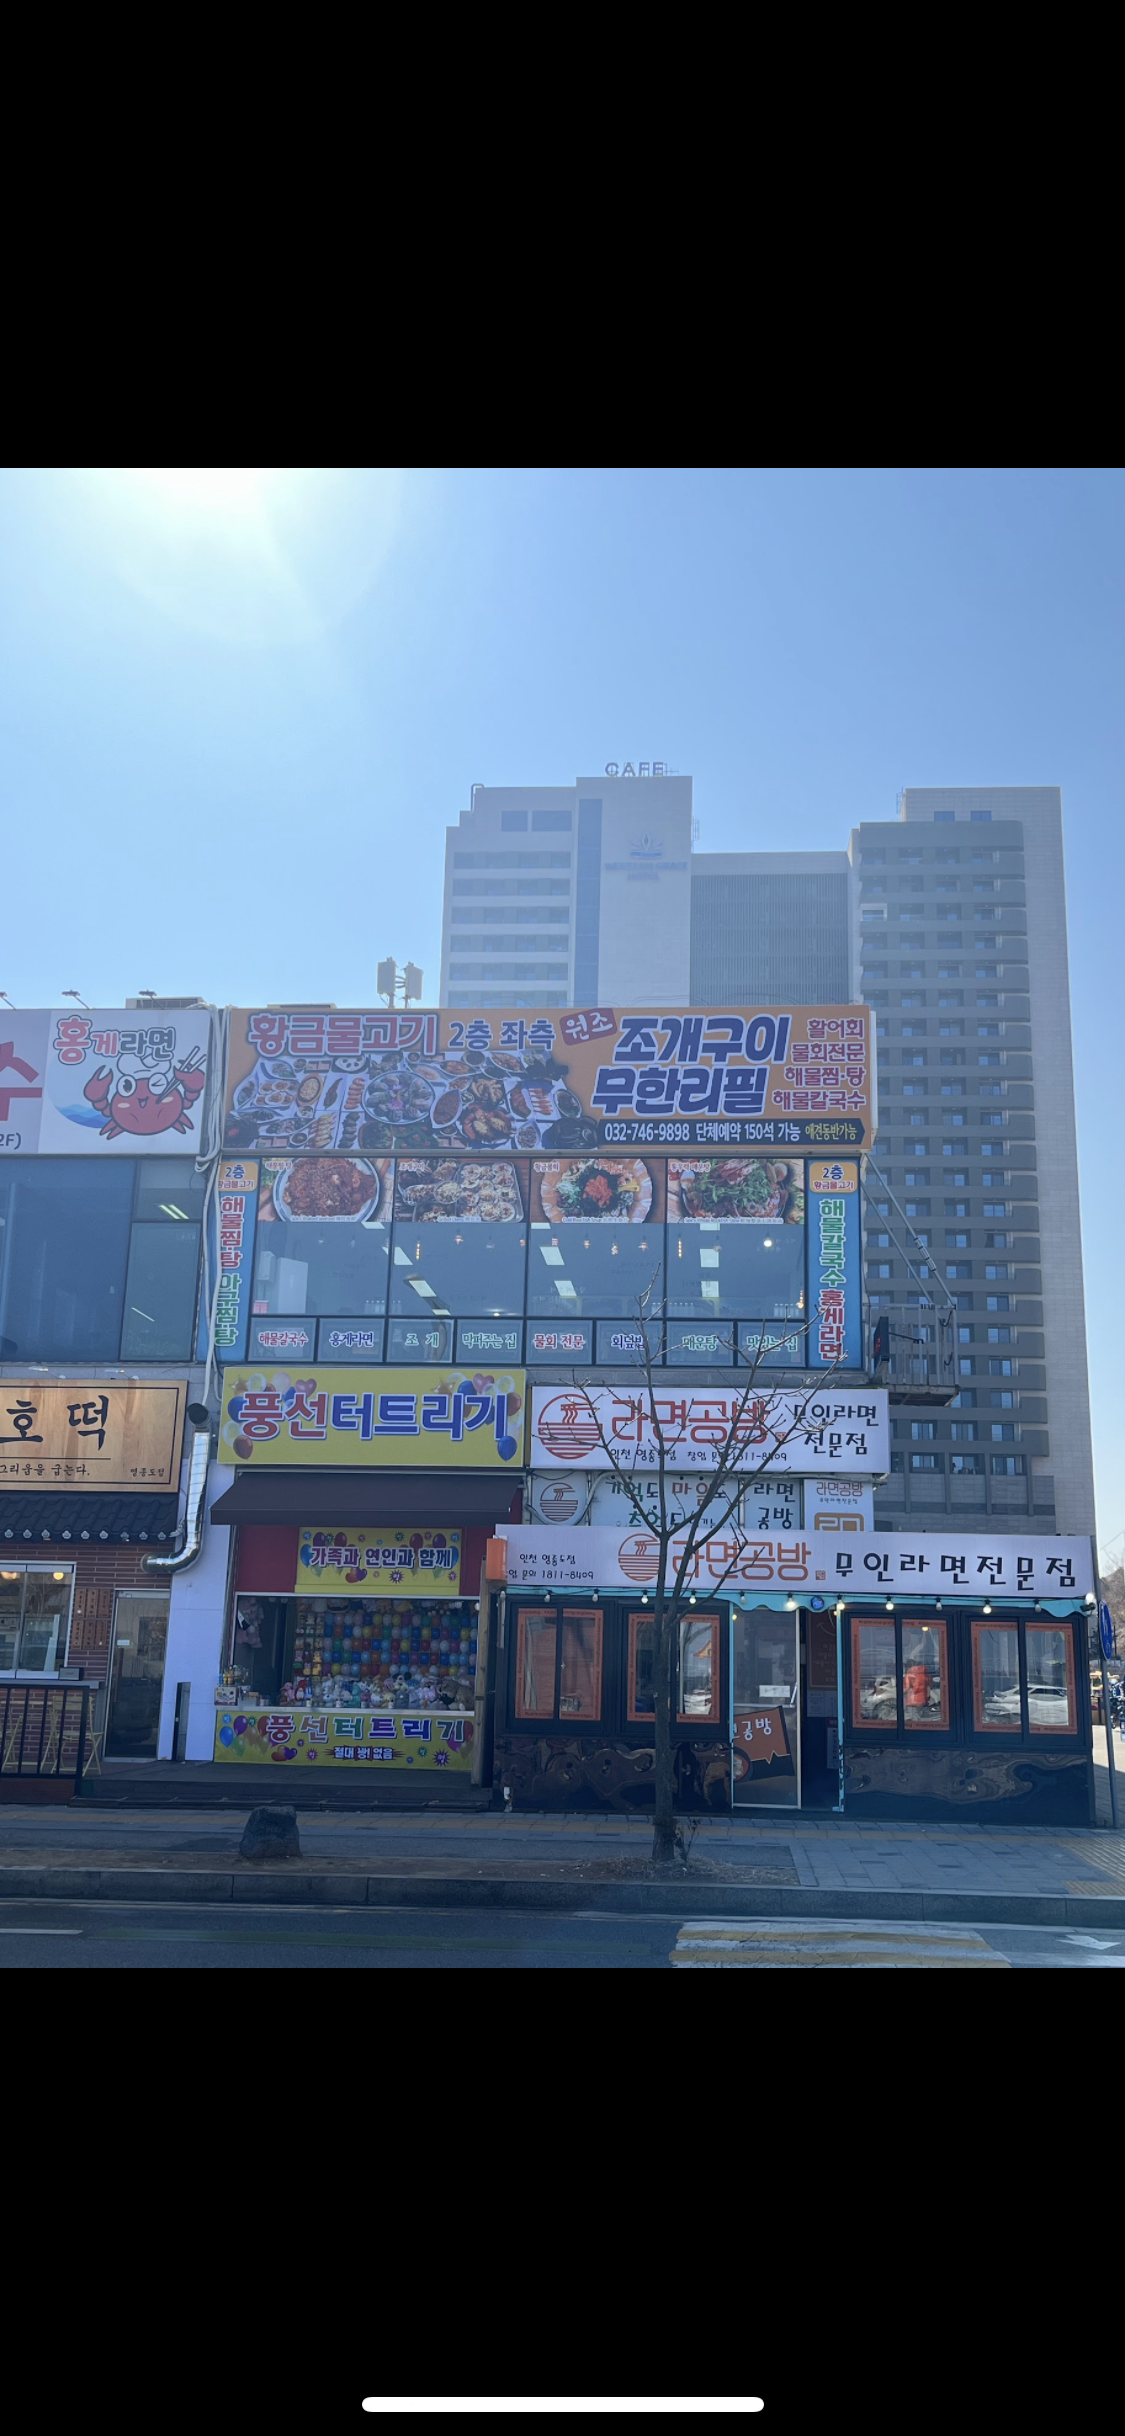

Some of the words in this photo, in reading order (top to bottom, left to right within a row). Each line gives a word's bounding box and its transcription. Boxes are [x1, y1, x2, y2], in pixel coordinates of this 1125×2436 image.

[604, 762, 664, 777] CAFE
[249, 1013, 438, 1057] 황금물고기
[449, 1020, 492, 1049] 2층
[500, 1019, 555, 1050] 좌측
[564, 1012, 614, 1040] 원조
[807, 1018, 864, 1039] 활어회
[54, 1015, 175, 1065] 홍게라면
[614, 1015, 791, 1063] 조개구이
[791, 1043, 865, 1063] 물회전문
[591, 1065, 770, 1116] 무한리필
[772, 1090, 866, 1111] 해물칼국수
[605, 1123, 690, 1141] 032-746-9898
[696, 1123, 741, 1142] 단체예약
[744, 1123, 774, 1142] 150석
[778, 1123, 801, 1142] 가능
[805, 1124, 857, 1141] 애견동반가능
[225, 1165, 245, 1180] 2층
[822, 1165, 844, 1180] 2층
[813, 1180, 855, 1190] 황금물고기
[819, 1199, 846, 1287] 해물칼국수
[818, 1289, 845, 1361] 홍게라면
[259, 1332, 309, 1347] 해물칼국수
[329, 1331, 374, 1348] 홍게라면
[461, 1332, 503, 1348] 막퍼주는
[504, 1333, 517, 1349] 집
[533, 1333, 557, 1349] 물회
[560, 1334, 586, 1349] 전문
[682, 1335, 717, 1351] 매운탕
[0, 1395, 110, 1451] 호떡
[238, 1391, 508, 1441] 풍선터트리기
[611, 1399, 770, 1444] 라면공방
[794, 1404, 879, 1427] 무인라면
[610, 1448, 631, 1460] 인천
[636, 1448, 677, 1463] 영종점
[687, 1451, 707, 1461] 창업
[804, 1433, 868, 1458] 전문점
[51, 1464, 91, 1476] 굽는다.
[130, 1468, 165, 1478] 영종도점
[754, 1482, 796, 1504] 라면
[816, 1481, 864, 1497] 라면공방
[757, 1507, 793, 1531] 공방
[310, 1546, 361, 1568] 가족과
[365, 1547, 415, 1569] 연인과
[419, 1547, 453, 1569] 함께
[520, 1553, 537, 1563] 인천
[541, 1553, 576, 1566] 영종도점
[672, 1539, 812, 1582] 라면공방
[522, 1569, 537, 1580] 문의
[542, 1569, 594, 1580] 1811-8409
[835, 1552, 1076, 1591] 무인라면전문점
[266, 1714, 466, 1744] 풍선터트리기
[334, 1747, 354, 1759] 절대
[373, 1747, 393, 1760] 없음
